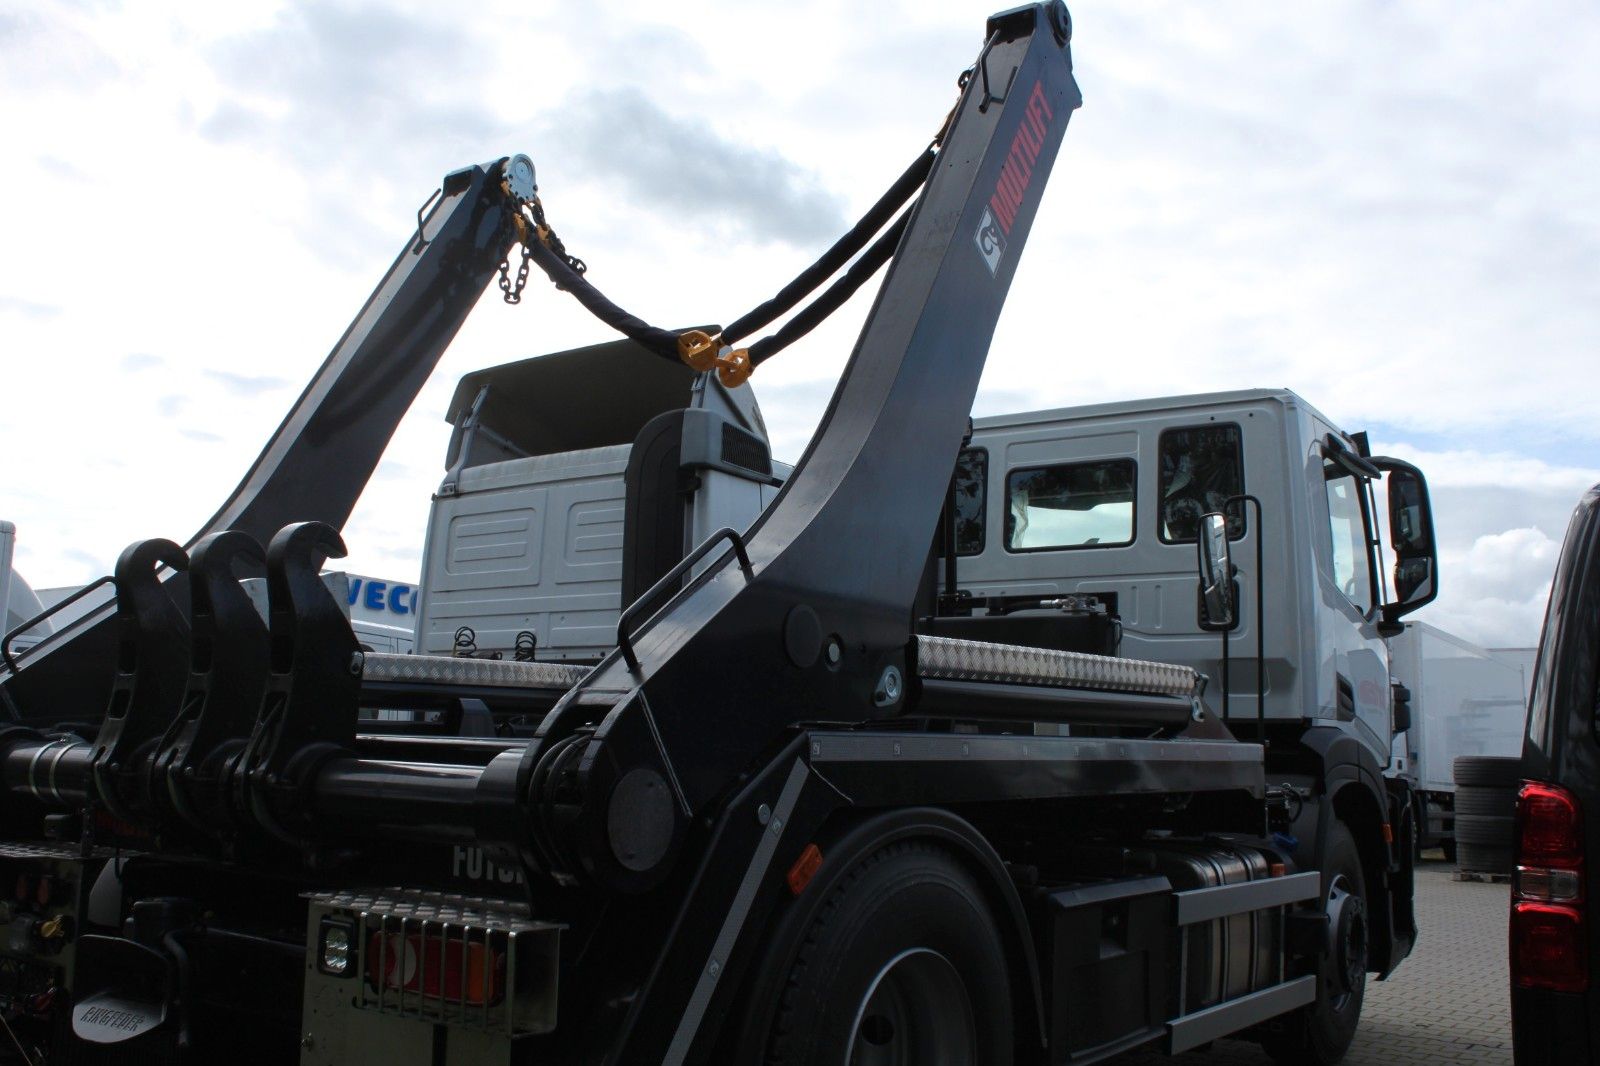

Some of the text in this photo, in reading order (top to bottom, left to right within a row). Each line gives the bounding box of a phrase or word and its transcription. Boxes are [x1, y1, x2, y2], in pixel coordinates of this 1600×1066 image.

[990, 80, 1053, 234] MULTILIFT
[347, 578, 418, 615] VEC
[80, 1006, 146, 1032] RINGFEDER
